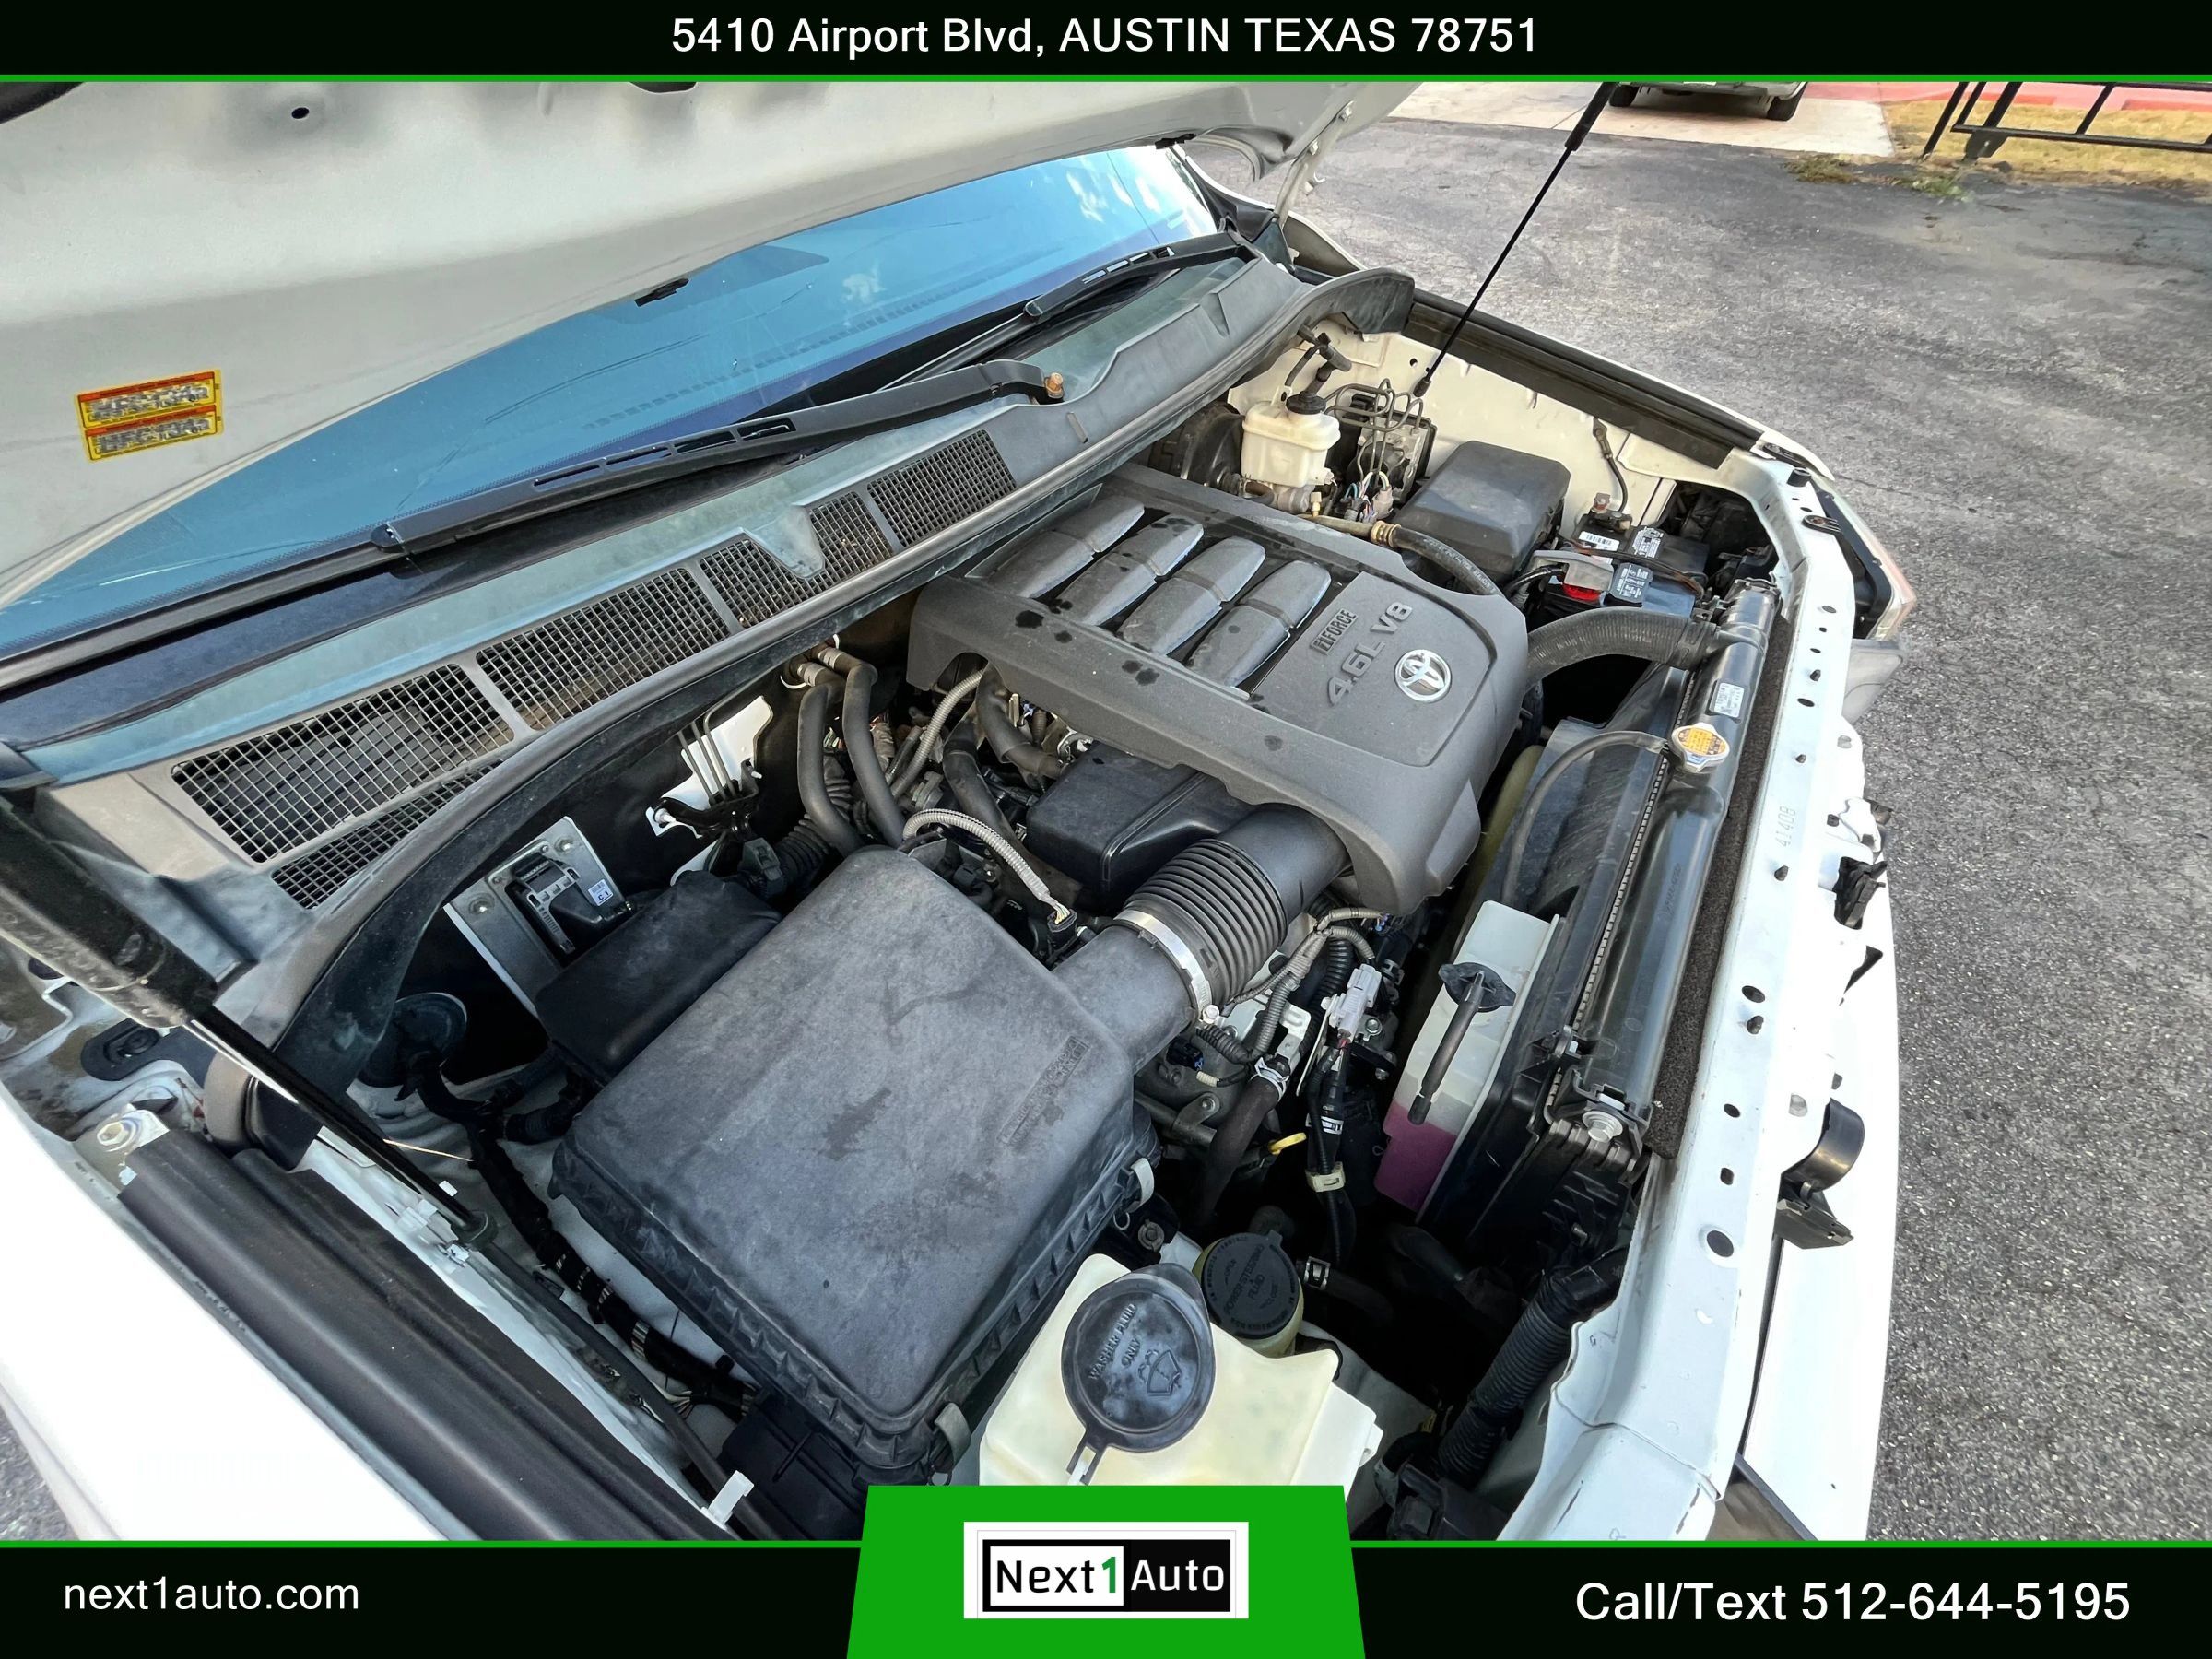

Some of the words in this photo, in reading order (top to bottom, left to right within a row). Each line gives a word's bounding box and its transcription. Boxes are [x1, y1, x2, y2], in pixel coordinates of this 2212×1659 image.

[1371, 601, 1413, 634] V8
[1247, 1274, 1266, 1300] FLUID
[1088, 1334, 1121, 1381] WASHER
[1113, 1302, 1136, 1335] FLUID
[1121, 1336, 1141, 1368] ONLY
